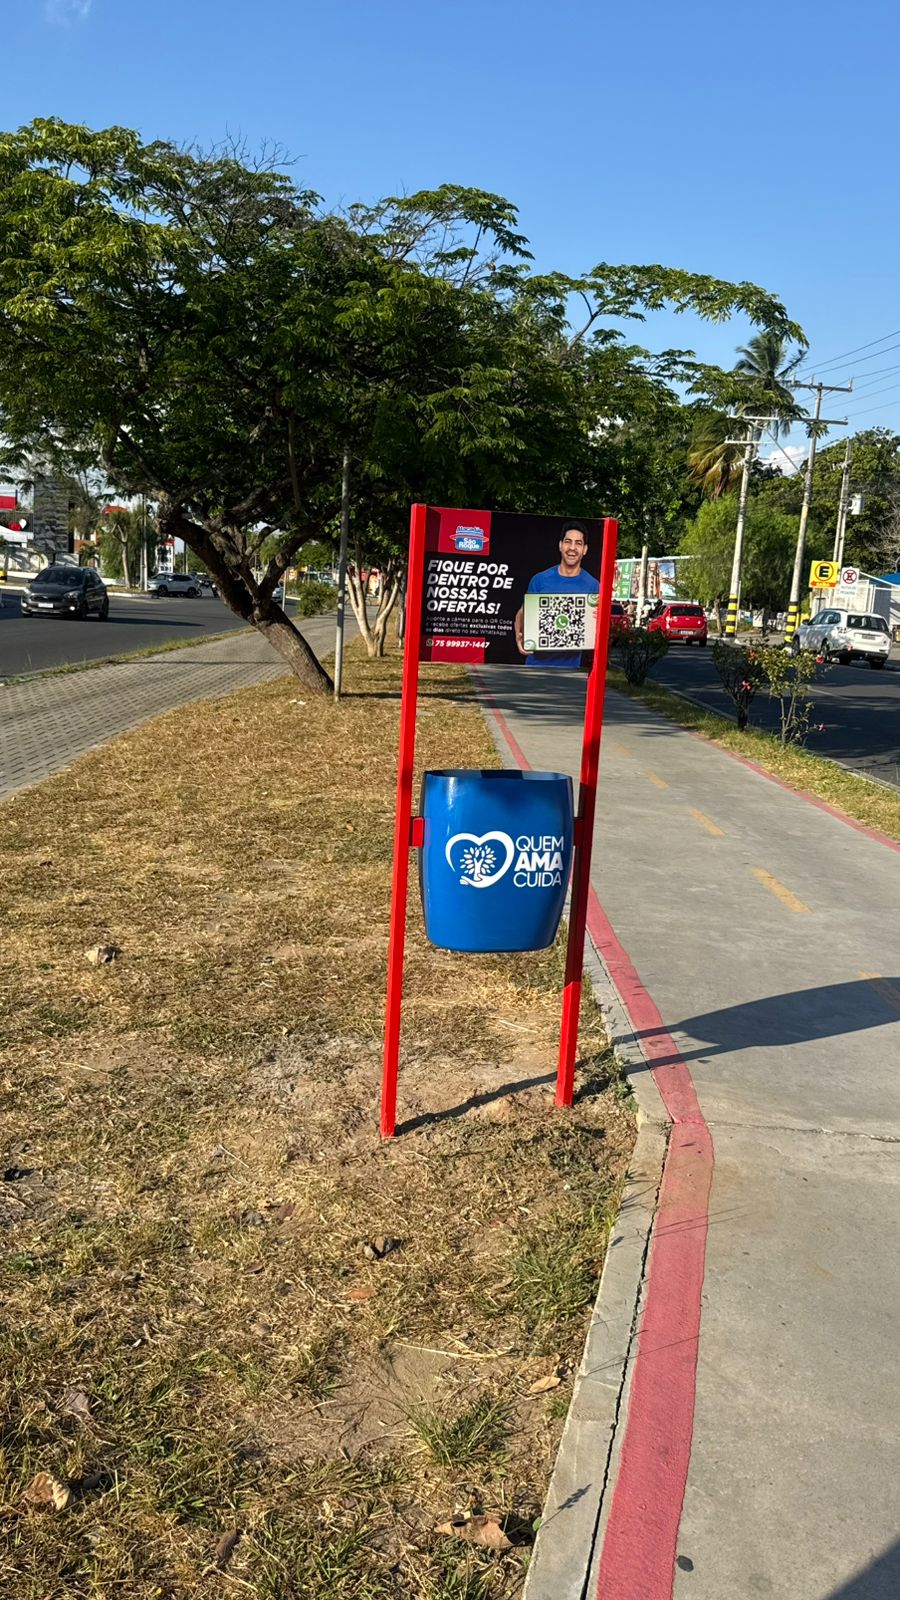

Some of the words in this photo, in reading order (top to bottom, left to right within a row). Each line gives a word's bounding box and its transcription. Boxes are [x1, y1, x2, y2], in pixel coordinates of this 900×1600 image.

[458, 541, 480, 551] Roque
[428, 559, 475, 574] FIQUE
[477, 562, 509, 576] POR
[819, 566, 830, 578] E
[427, 573, 490, 588] DENTRO
[492, 577, 514, 589] DE
[426, 586, 489, 601] NOSSAS
[426, 600, 501, 615] OFERTAS!
[445, 640, 490, 649] 99937-1447
[516, 836, 564, 852] QUEM
[514, 852, 564, 872] AMA
[514, 872, 562, 888] CUIDA
